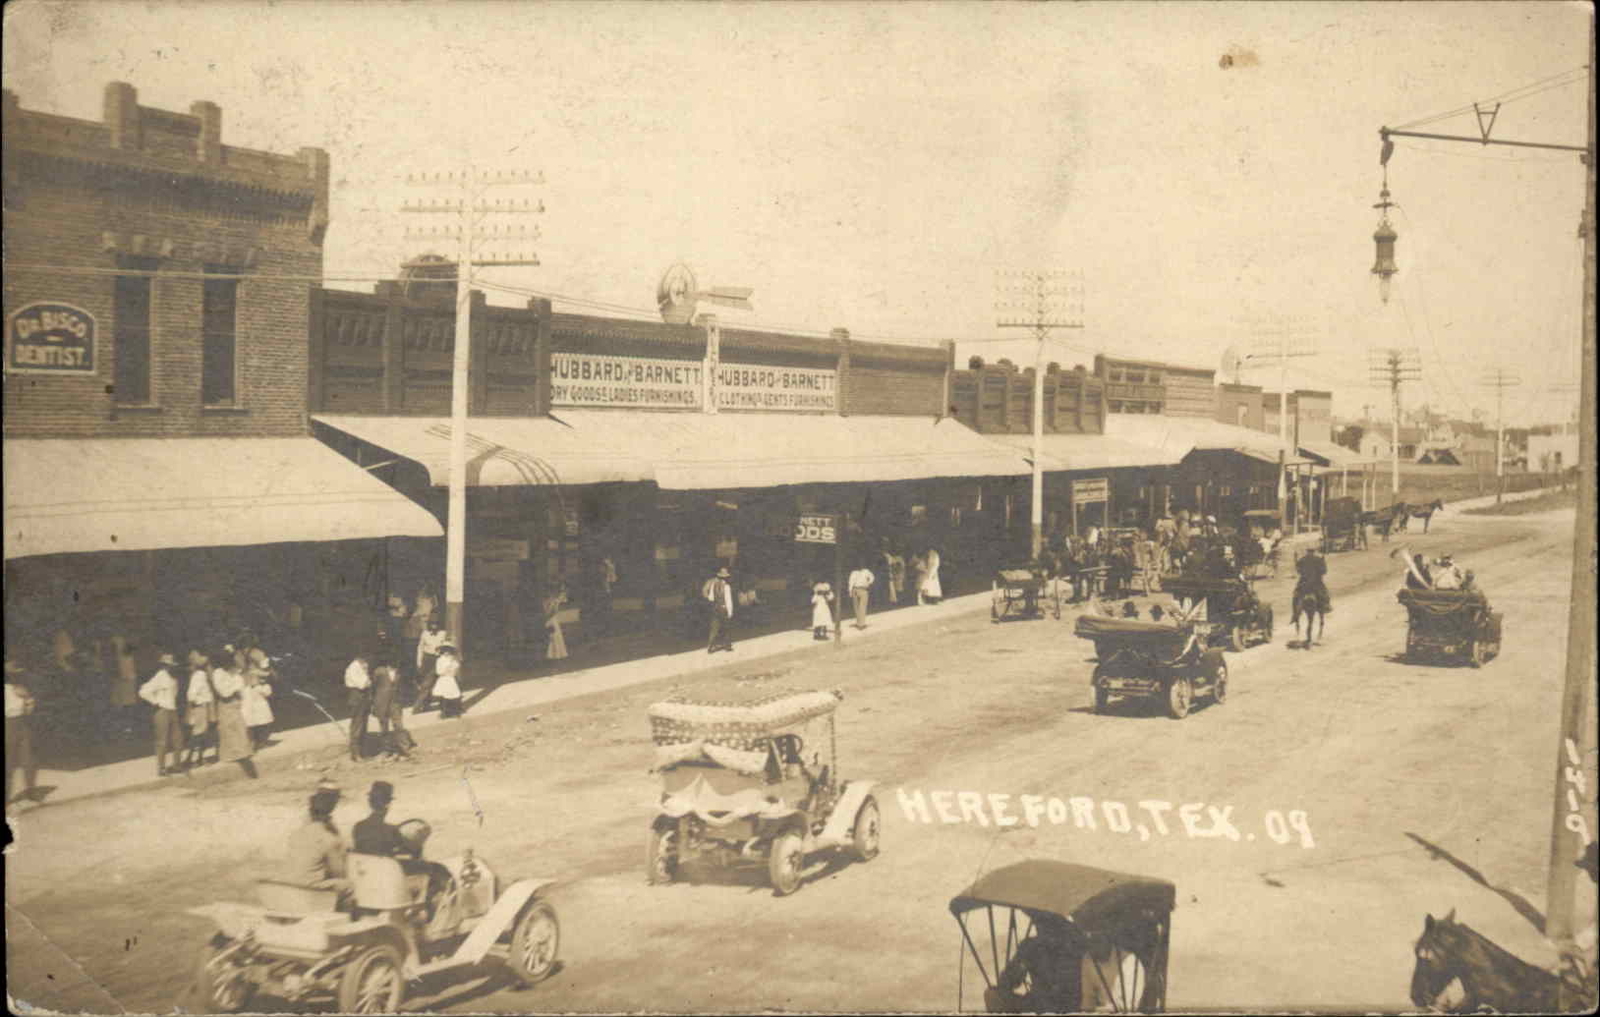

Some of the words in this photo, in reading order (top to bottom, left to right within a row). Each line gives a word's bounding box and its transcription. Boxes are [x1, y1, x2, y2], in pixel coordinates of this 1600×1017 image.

[550, 360, 623, 381] HUBBARD
[718, 370, 774, 387] HUBBARD
[783, 372, 834, 390] BARNETT
[550, 384, 568, 401] DRY
[570, 385, 601, 402] GOODS
[609, 387, 638, 403] LADIES
[764, 393, 787, 406] GENTS
